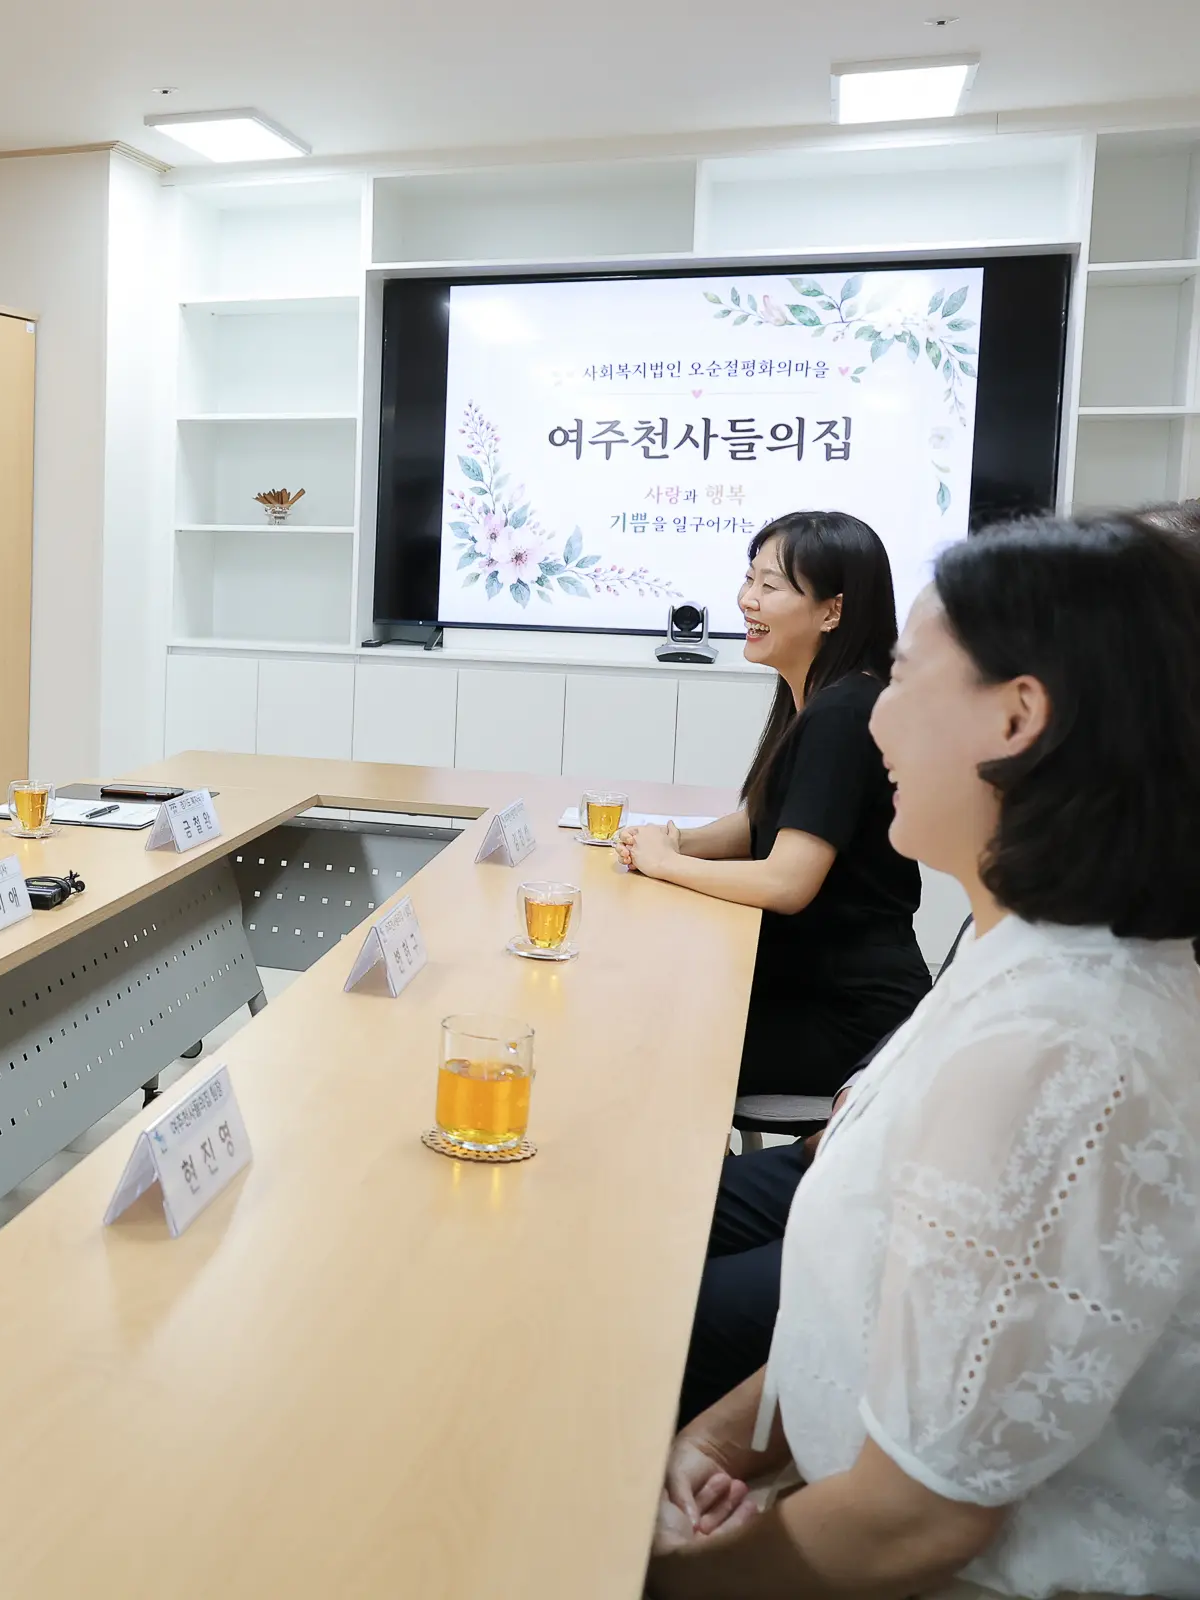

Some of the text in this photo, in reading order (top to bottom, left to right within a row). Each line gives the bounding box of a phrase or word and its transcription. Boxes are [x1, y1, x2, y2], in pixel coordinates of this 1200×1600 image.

[583, 359, 829, 381] 사회복지법인 오순절평화의마을
[548, 416, 852, 461] 여주천사들의집
[644, 484, 746, 506] 사랑과 행복
[609, 512, 667, 534] 기쁨을
[672, 515, 755, 534] 일구어가는
